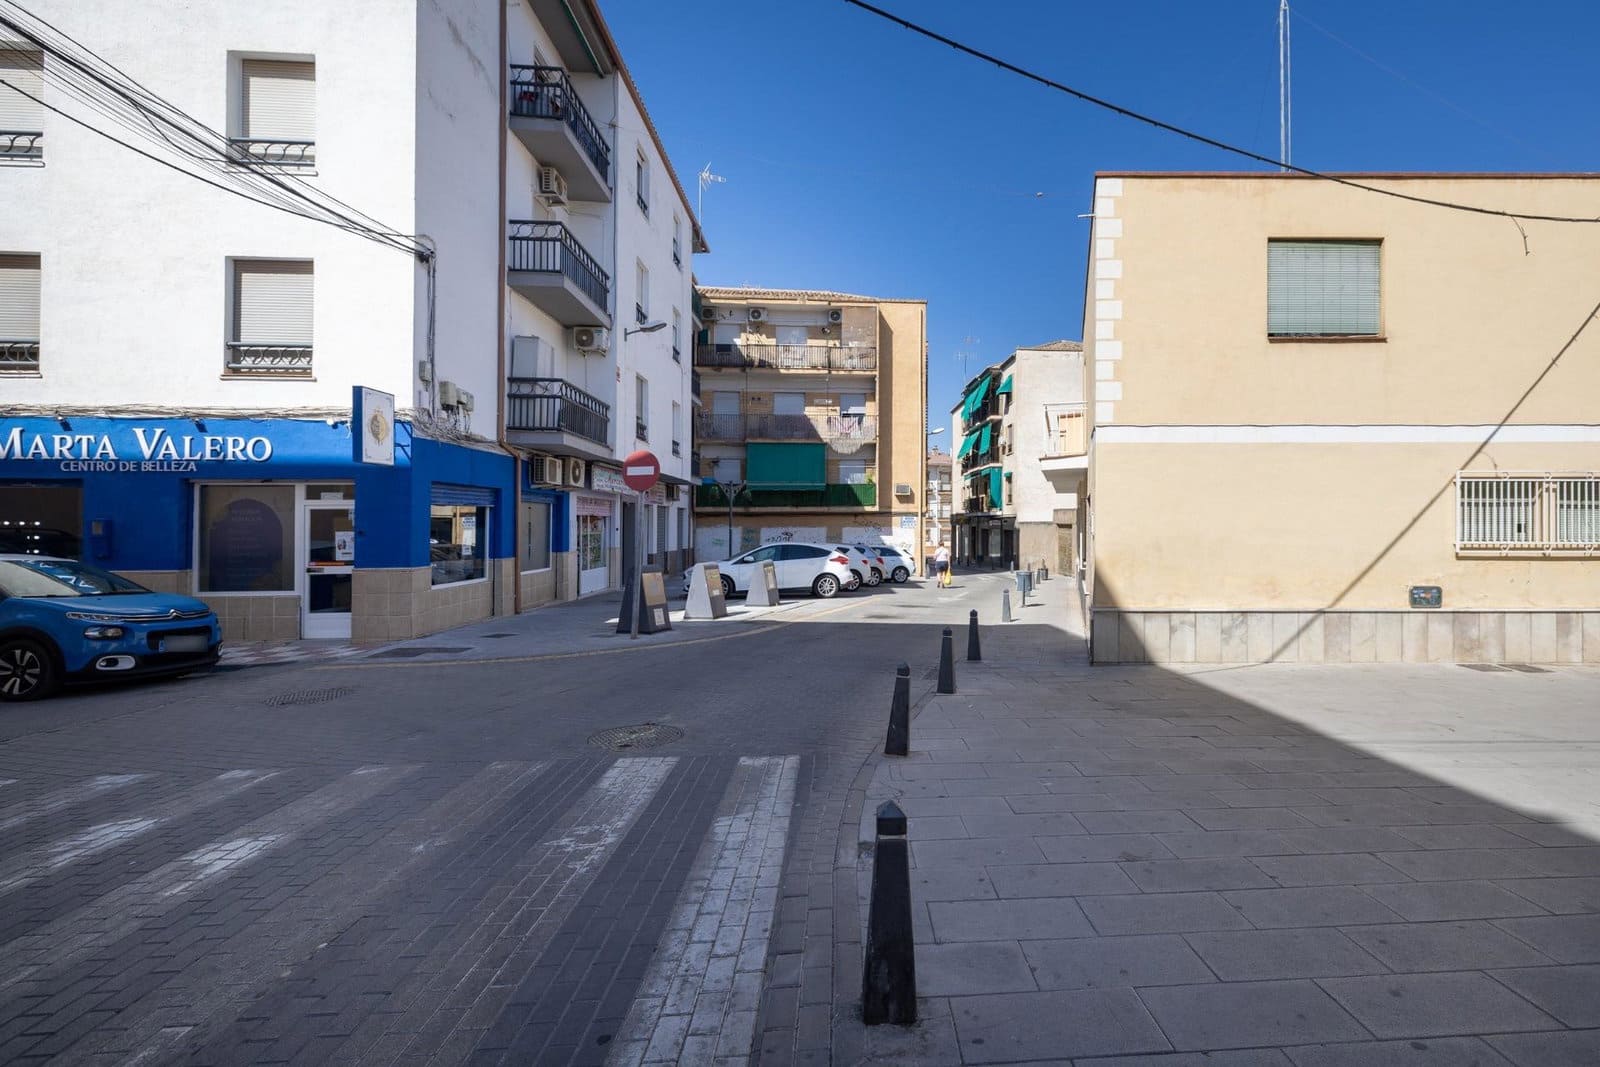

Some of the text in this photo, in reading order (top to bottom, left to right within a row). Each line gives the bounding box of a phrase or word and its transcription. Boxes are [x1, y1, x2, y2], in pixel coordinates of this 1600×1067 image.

[132, 427, 272, 462] VALERO
[60, 460, 197, 472] CENTRO DE BELLEZA
